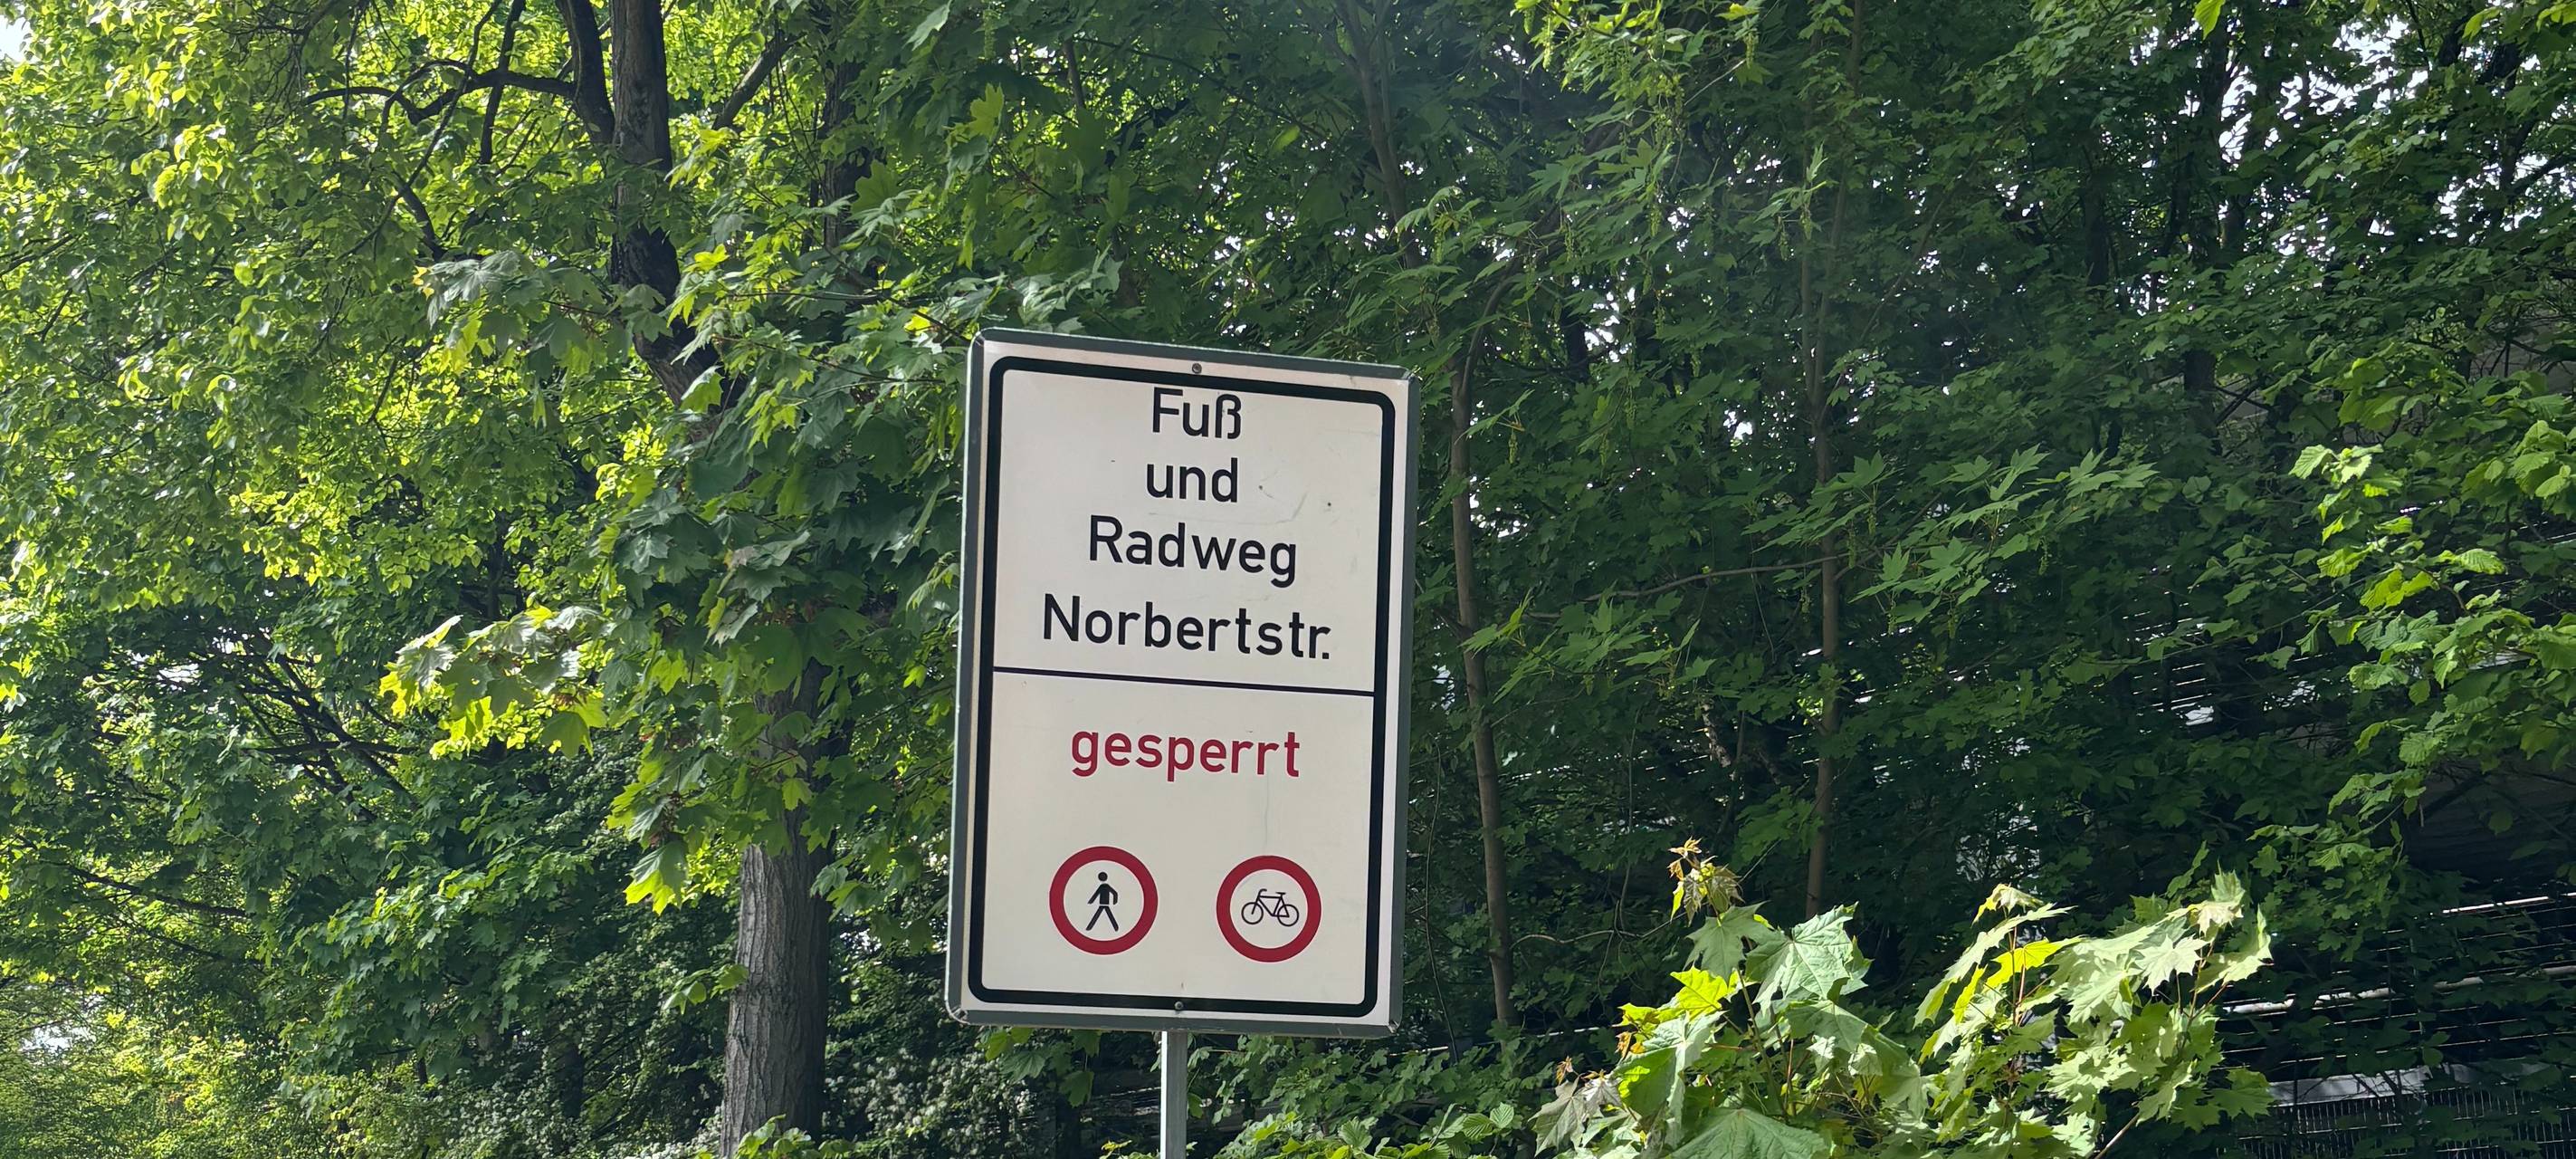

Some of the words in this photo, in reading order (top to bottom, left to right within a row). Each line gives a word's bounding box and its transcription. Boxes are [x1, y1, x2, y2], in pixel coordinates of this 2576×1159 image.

[1152, 387, 1242, 439] Fuß
[1146, 457, 1238, 503] und
[1089, 514, 1297, 588] Radweg
[1043, 593, 1331, 659] Norbertstr.
[1072, 731, 1300, 782] gesperrt
